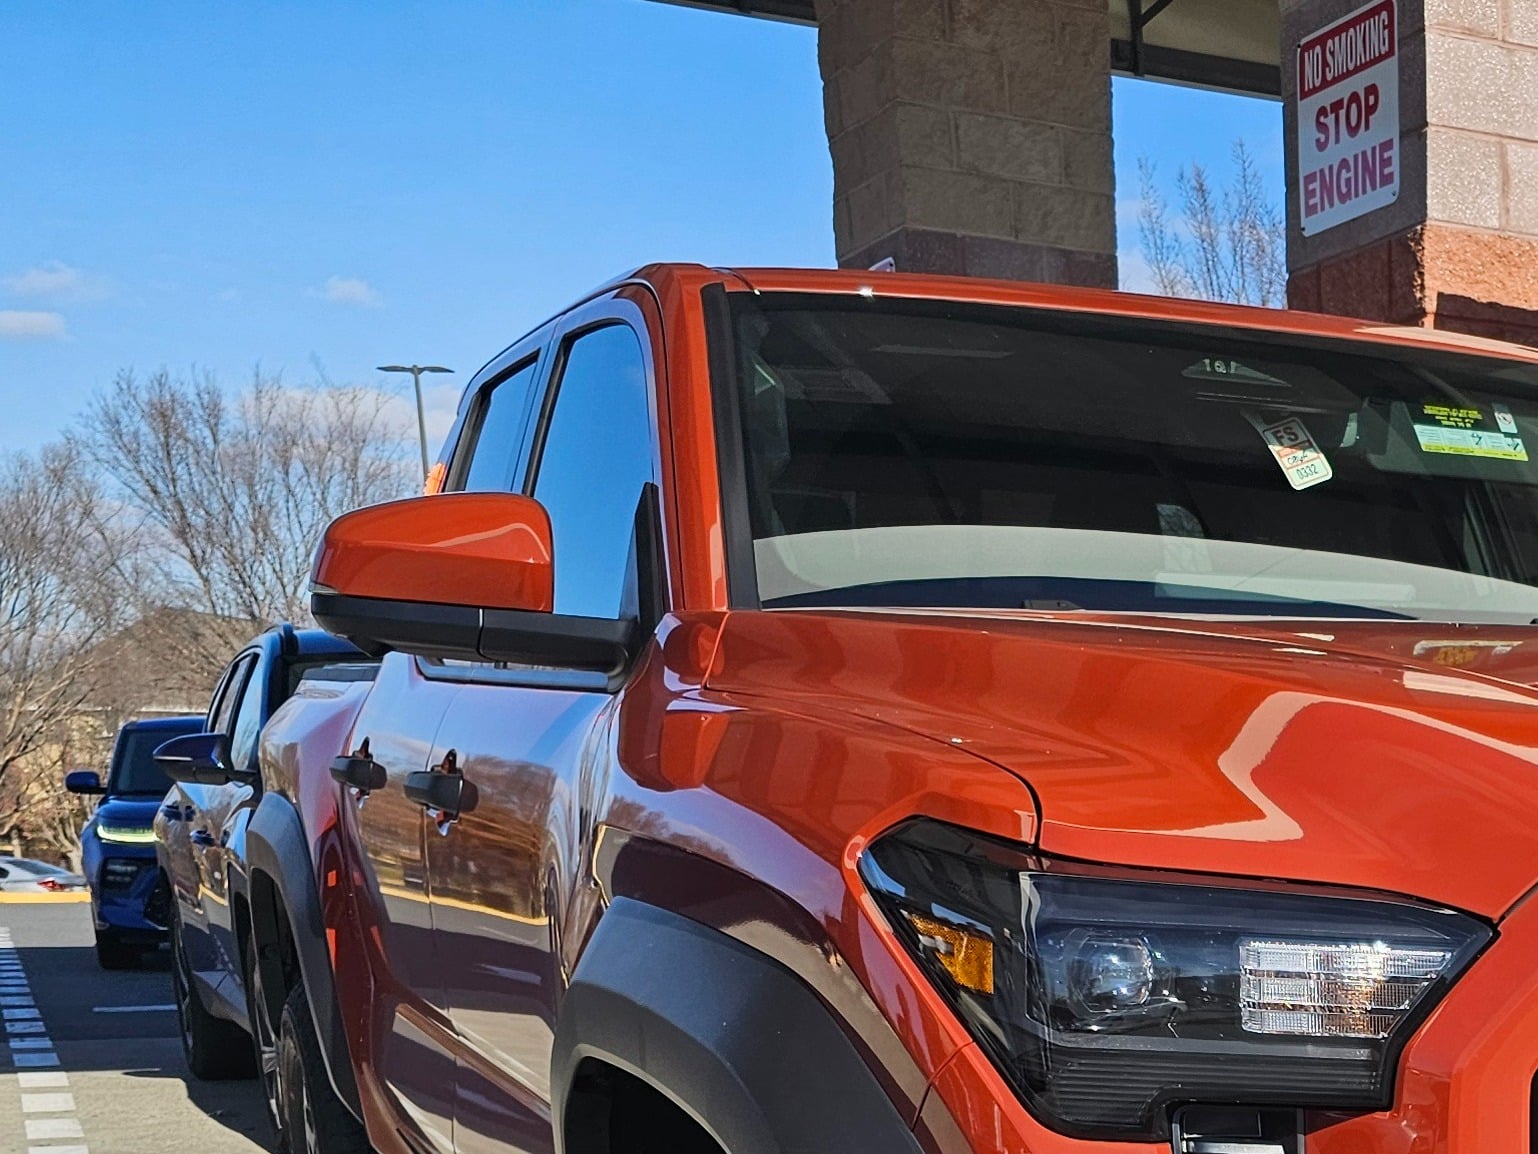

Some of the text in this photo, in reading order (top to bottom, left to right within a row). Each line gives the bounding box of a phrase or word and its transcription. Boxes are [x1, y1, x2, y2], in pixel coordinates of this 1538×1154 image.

[1304, 11, 1389, 92] NO SMOKING
[1315, 83, 1379, 152] STOP
[1303, 138, 1394, 218] ENGINE
[1271, 426, 1299, 447] FS
